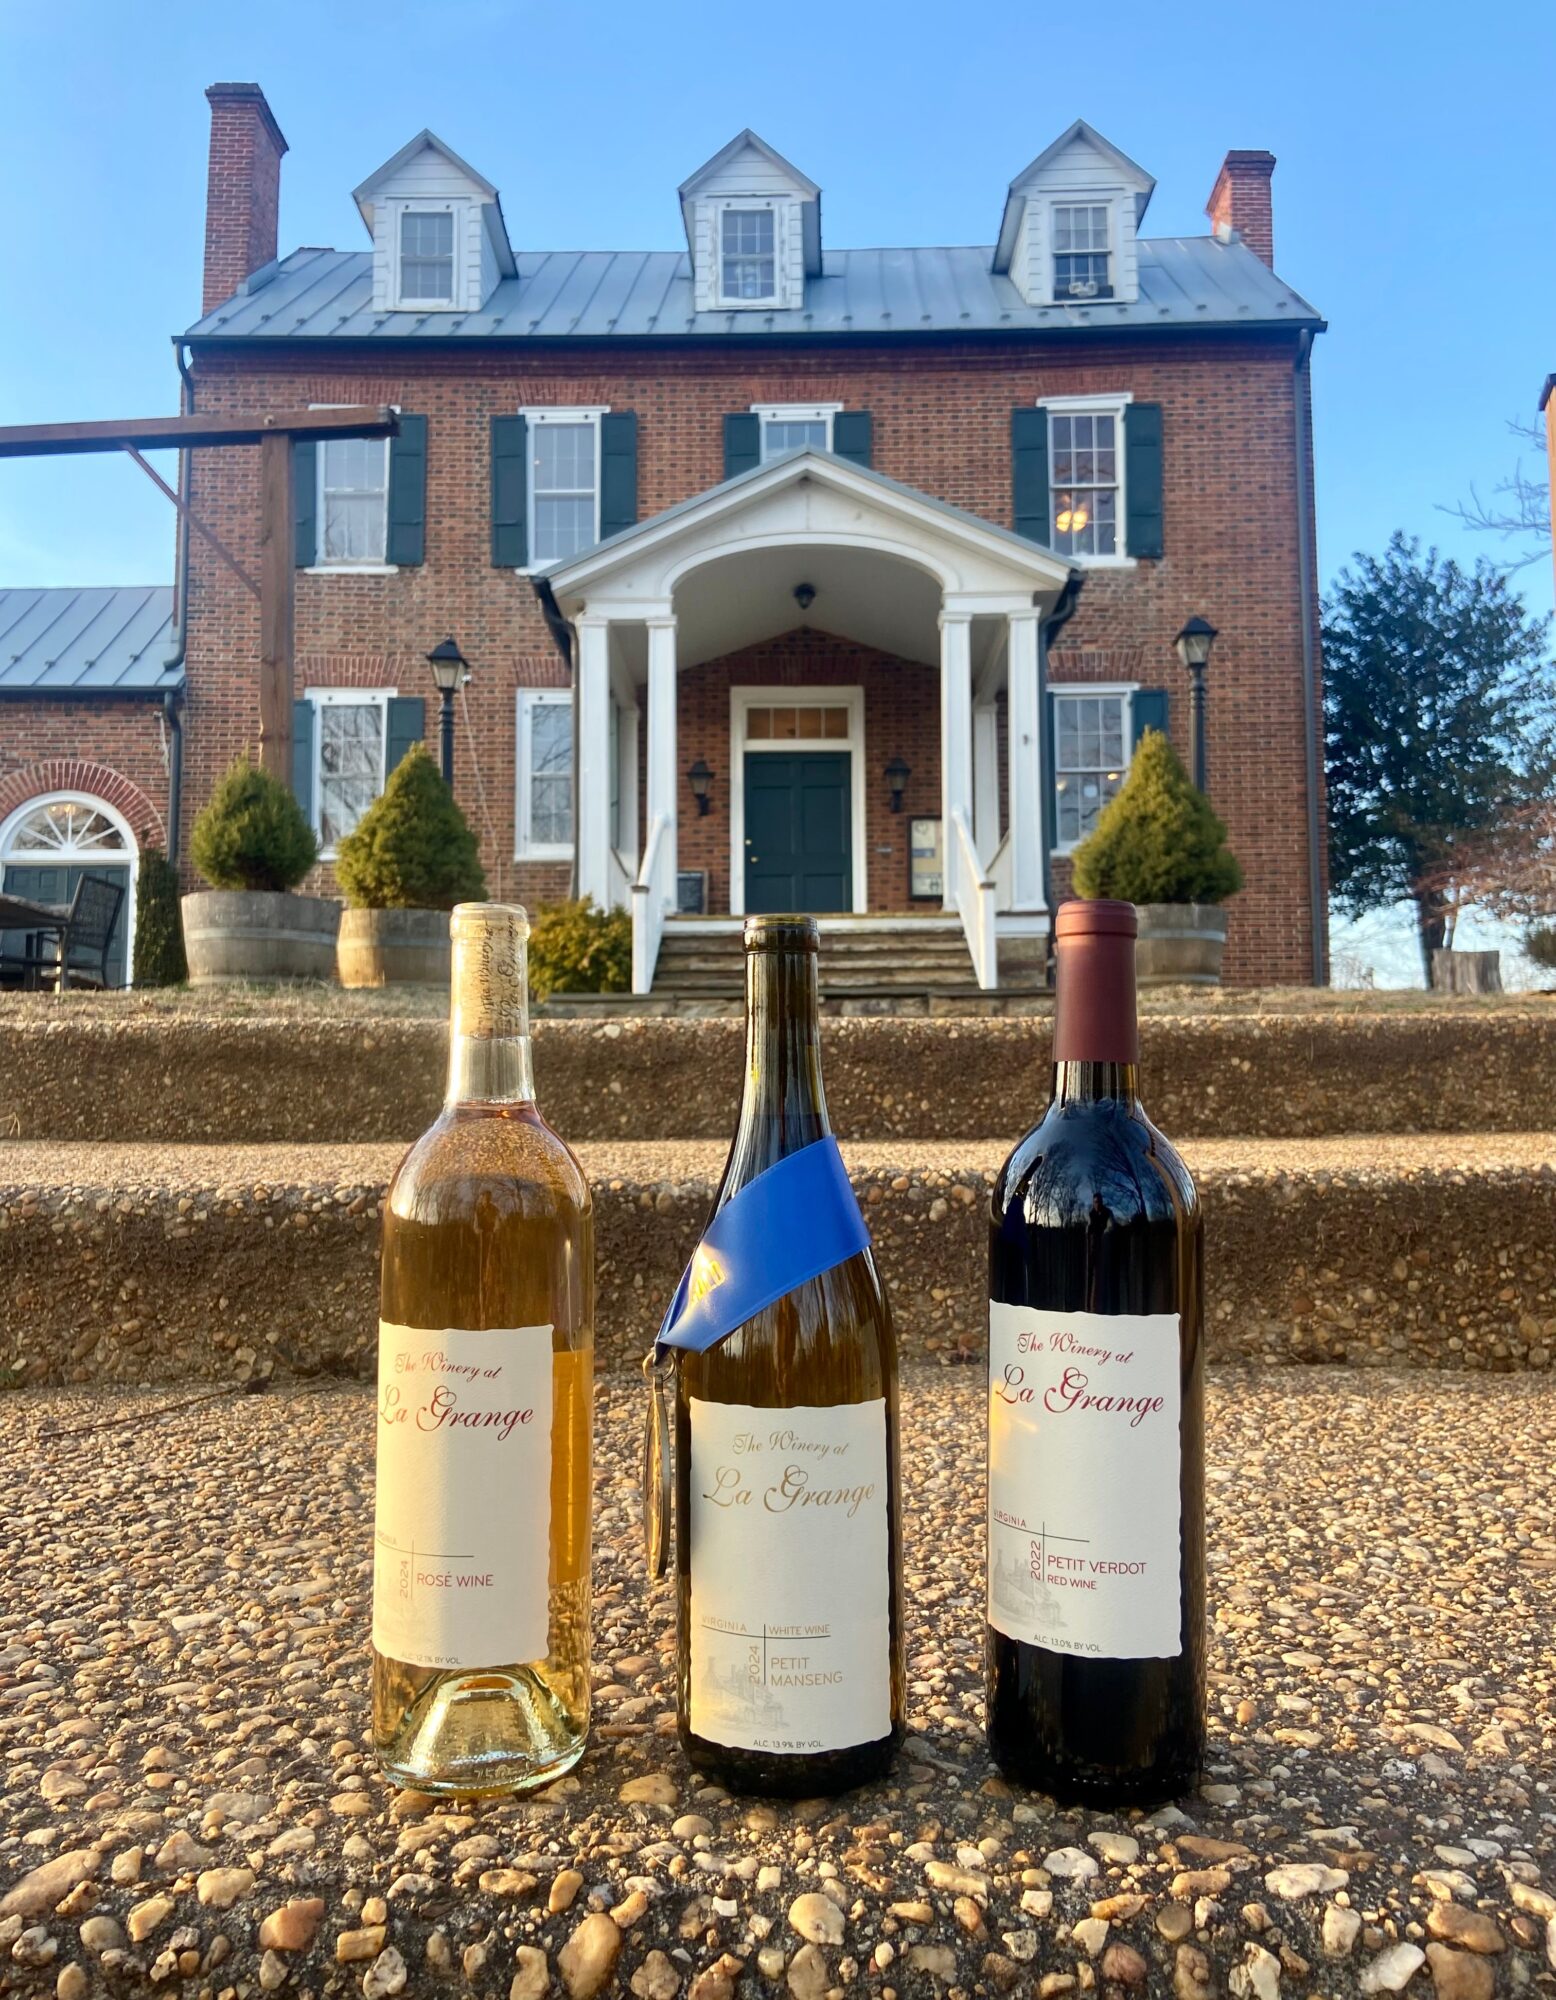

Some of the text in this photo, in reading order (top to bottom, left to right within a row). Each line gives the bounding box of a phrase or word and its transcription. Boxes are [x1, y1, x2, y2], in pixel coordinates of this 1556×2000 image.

[1017, 1332, 1134, 1366] The Winery at
[394, 1352, 502, 1382] The Winery at
[995, 1363, 1164, 1428] La Grange
[380, 1384, 534, 1441] La Grange
[732, 1430, 849, 1461] The Winery at
[702, 1464, 875, 1519] La Grange
[993, 1510, 1027, 1528] VIRGINIA
[1031, 1540, 1041, 1581] 2022
[1047, 1554, 1147, 1575] PETIT VERDOT
[400, 1560, 408, 1599] 2024
[417, 1571, 494, 1587] ROSÉ WINE
[1047, 1574, 1097, 1590] RED WINE
[702, 1616, 748, 1632] VIRGINIA
[769, 1624, 831, 1635] WHITE WINE
[1051, 1637, 1072, 1649] 13.0%
[1074, 1641, 1084, 1650] BY
[434, 1655, 445, 1664] BY
[748, 1644, 760, 1685] 2024
[771, 1657, 810, 1670] PETIT
[771, 1671, 843, 1687] MANSENG
[796, 1740, 806, 1749] BY
